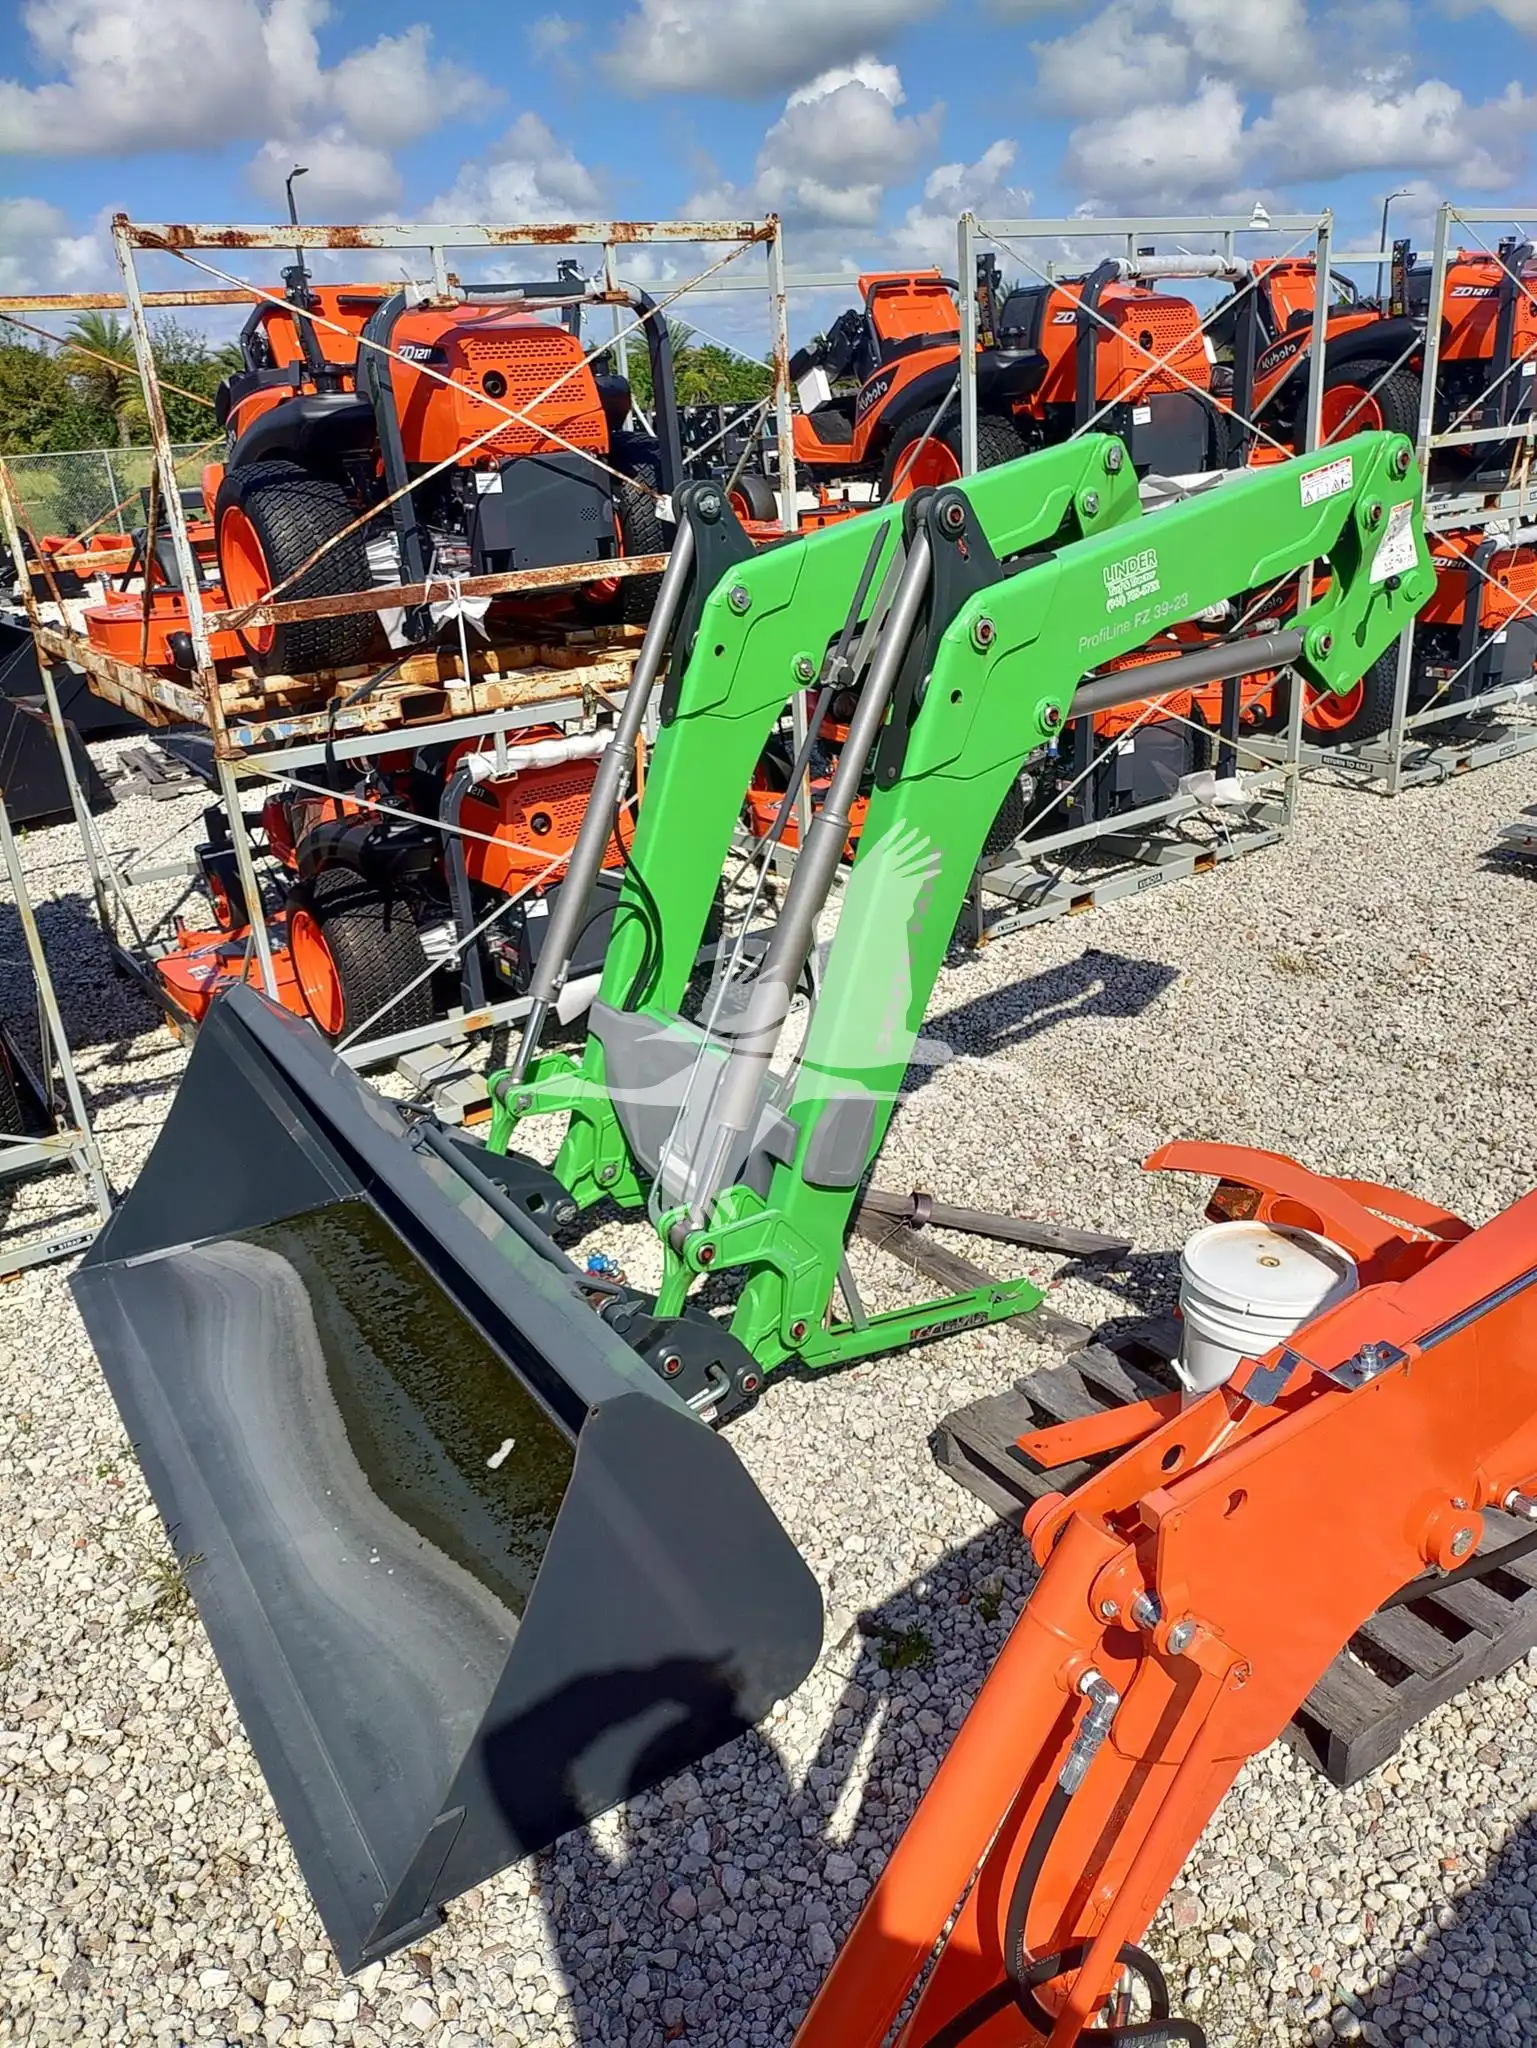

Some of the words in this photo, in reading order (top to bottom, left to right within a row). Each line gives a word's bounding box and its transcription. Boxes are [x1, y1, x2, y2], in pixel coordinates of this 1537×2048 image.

[1261, 343, 1297, 369] Kubota
[1102, 548, 1158, 585] LINDER
[1078, 620, 1131, 653] ProfiLine
[1134, 608, 1151, 628] FZ
[1153, 592, 1189, 619] 39-23
